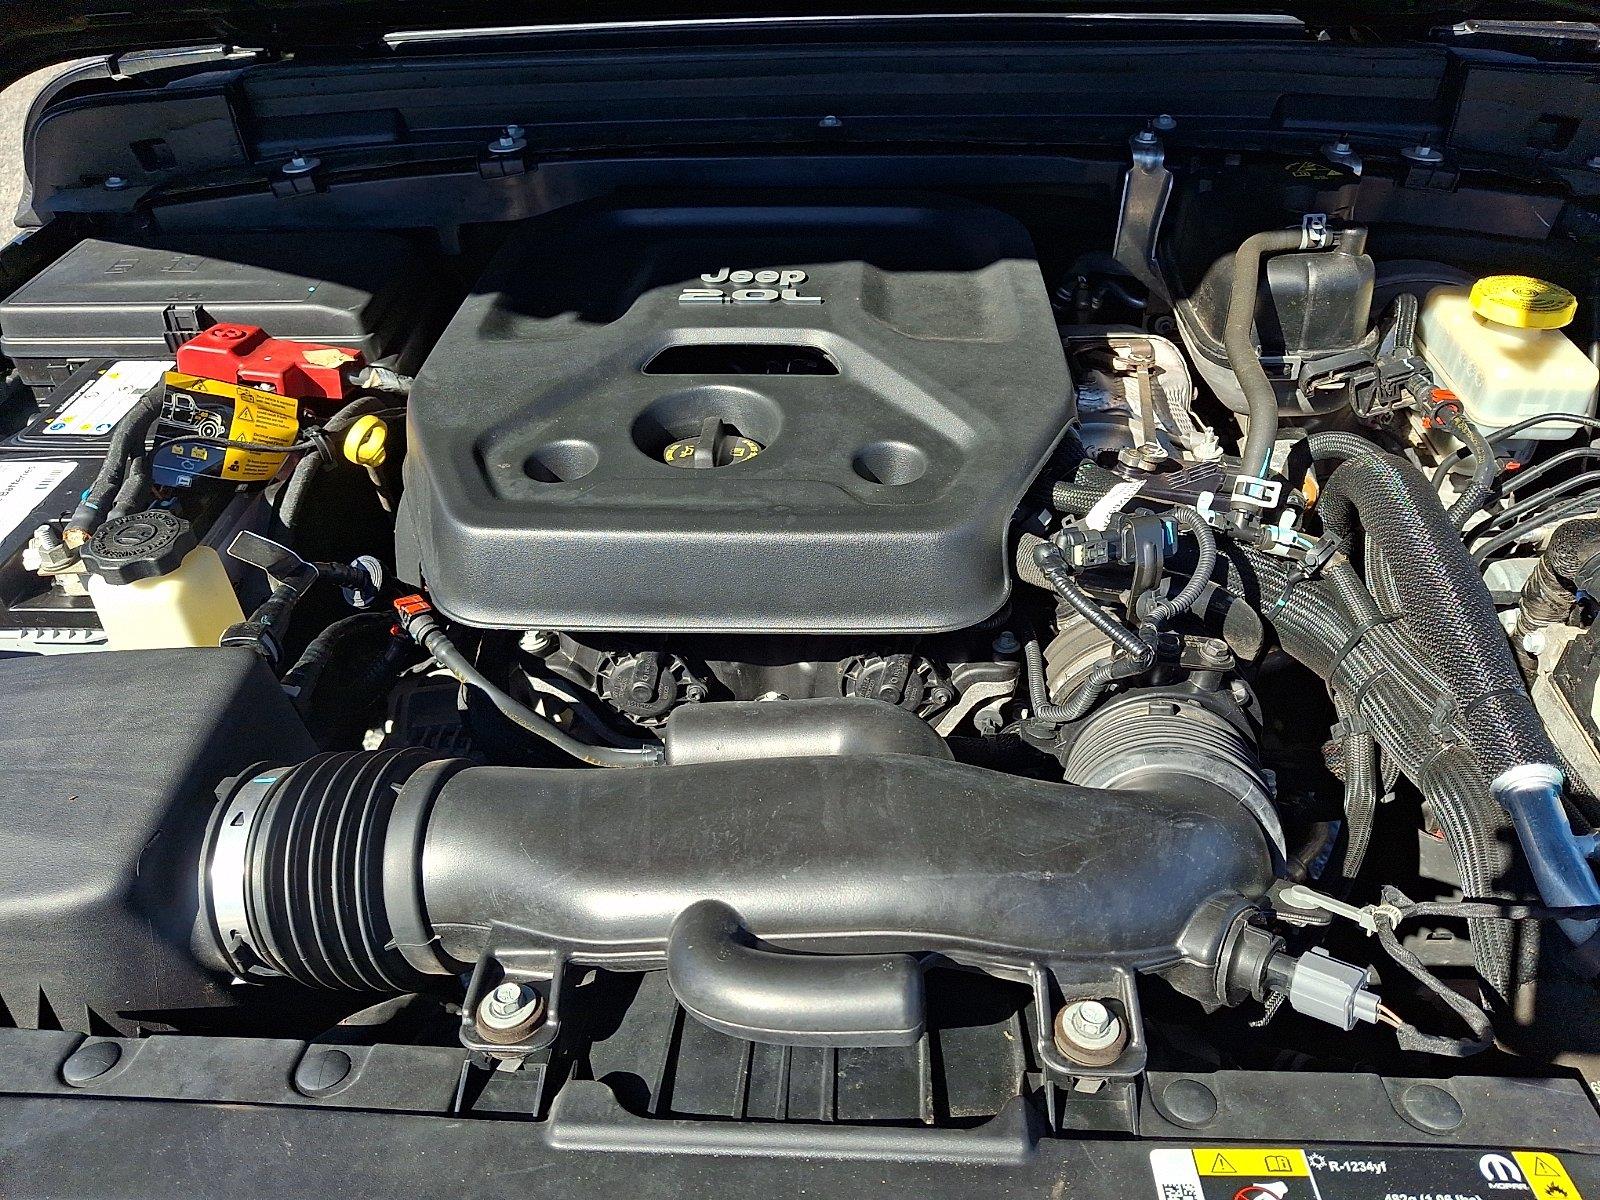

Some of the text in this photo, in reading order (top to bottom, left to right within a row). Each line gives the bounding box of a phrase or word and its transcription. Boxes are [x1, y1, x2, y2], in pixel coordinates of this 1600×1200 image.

[700, 267, 806, 287] Jeep
[678, 288, 822, 305] 2.0L
[1328, 1160, 1387, 1175] R-1234yf
[1487, 1182, 1530, 1191] MOPAR
